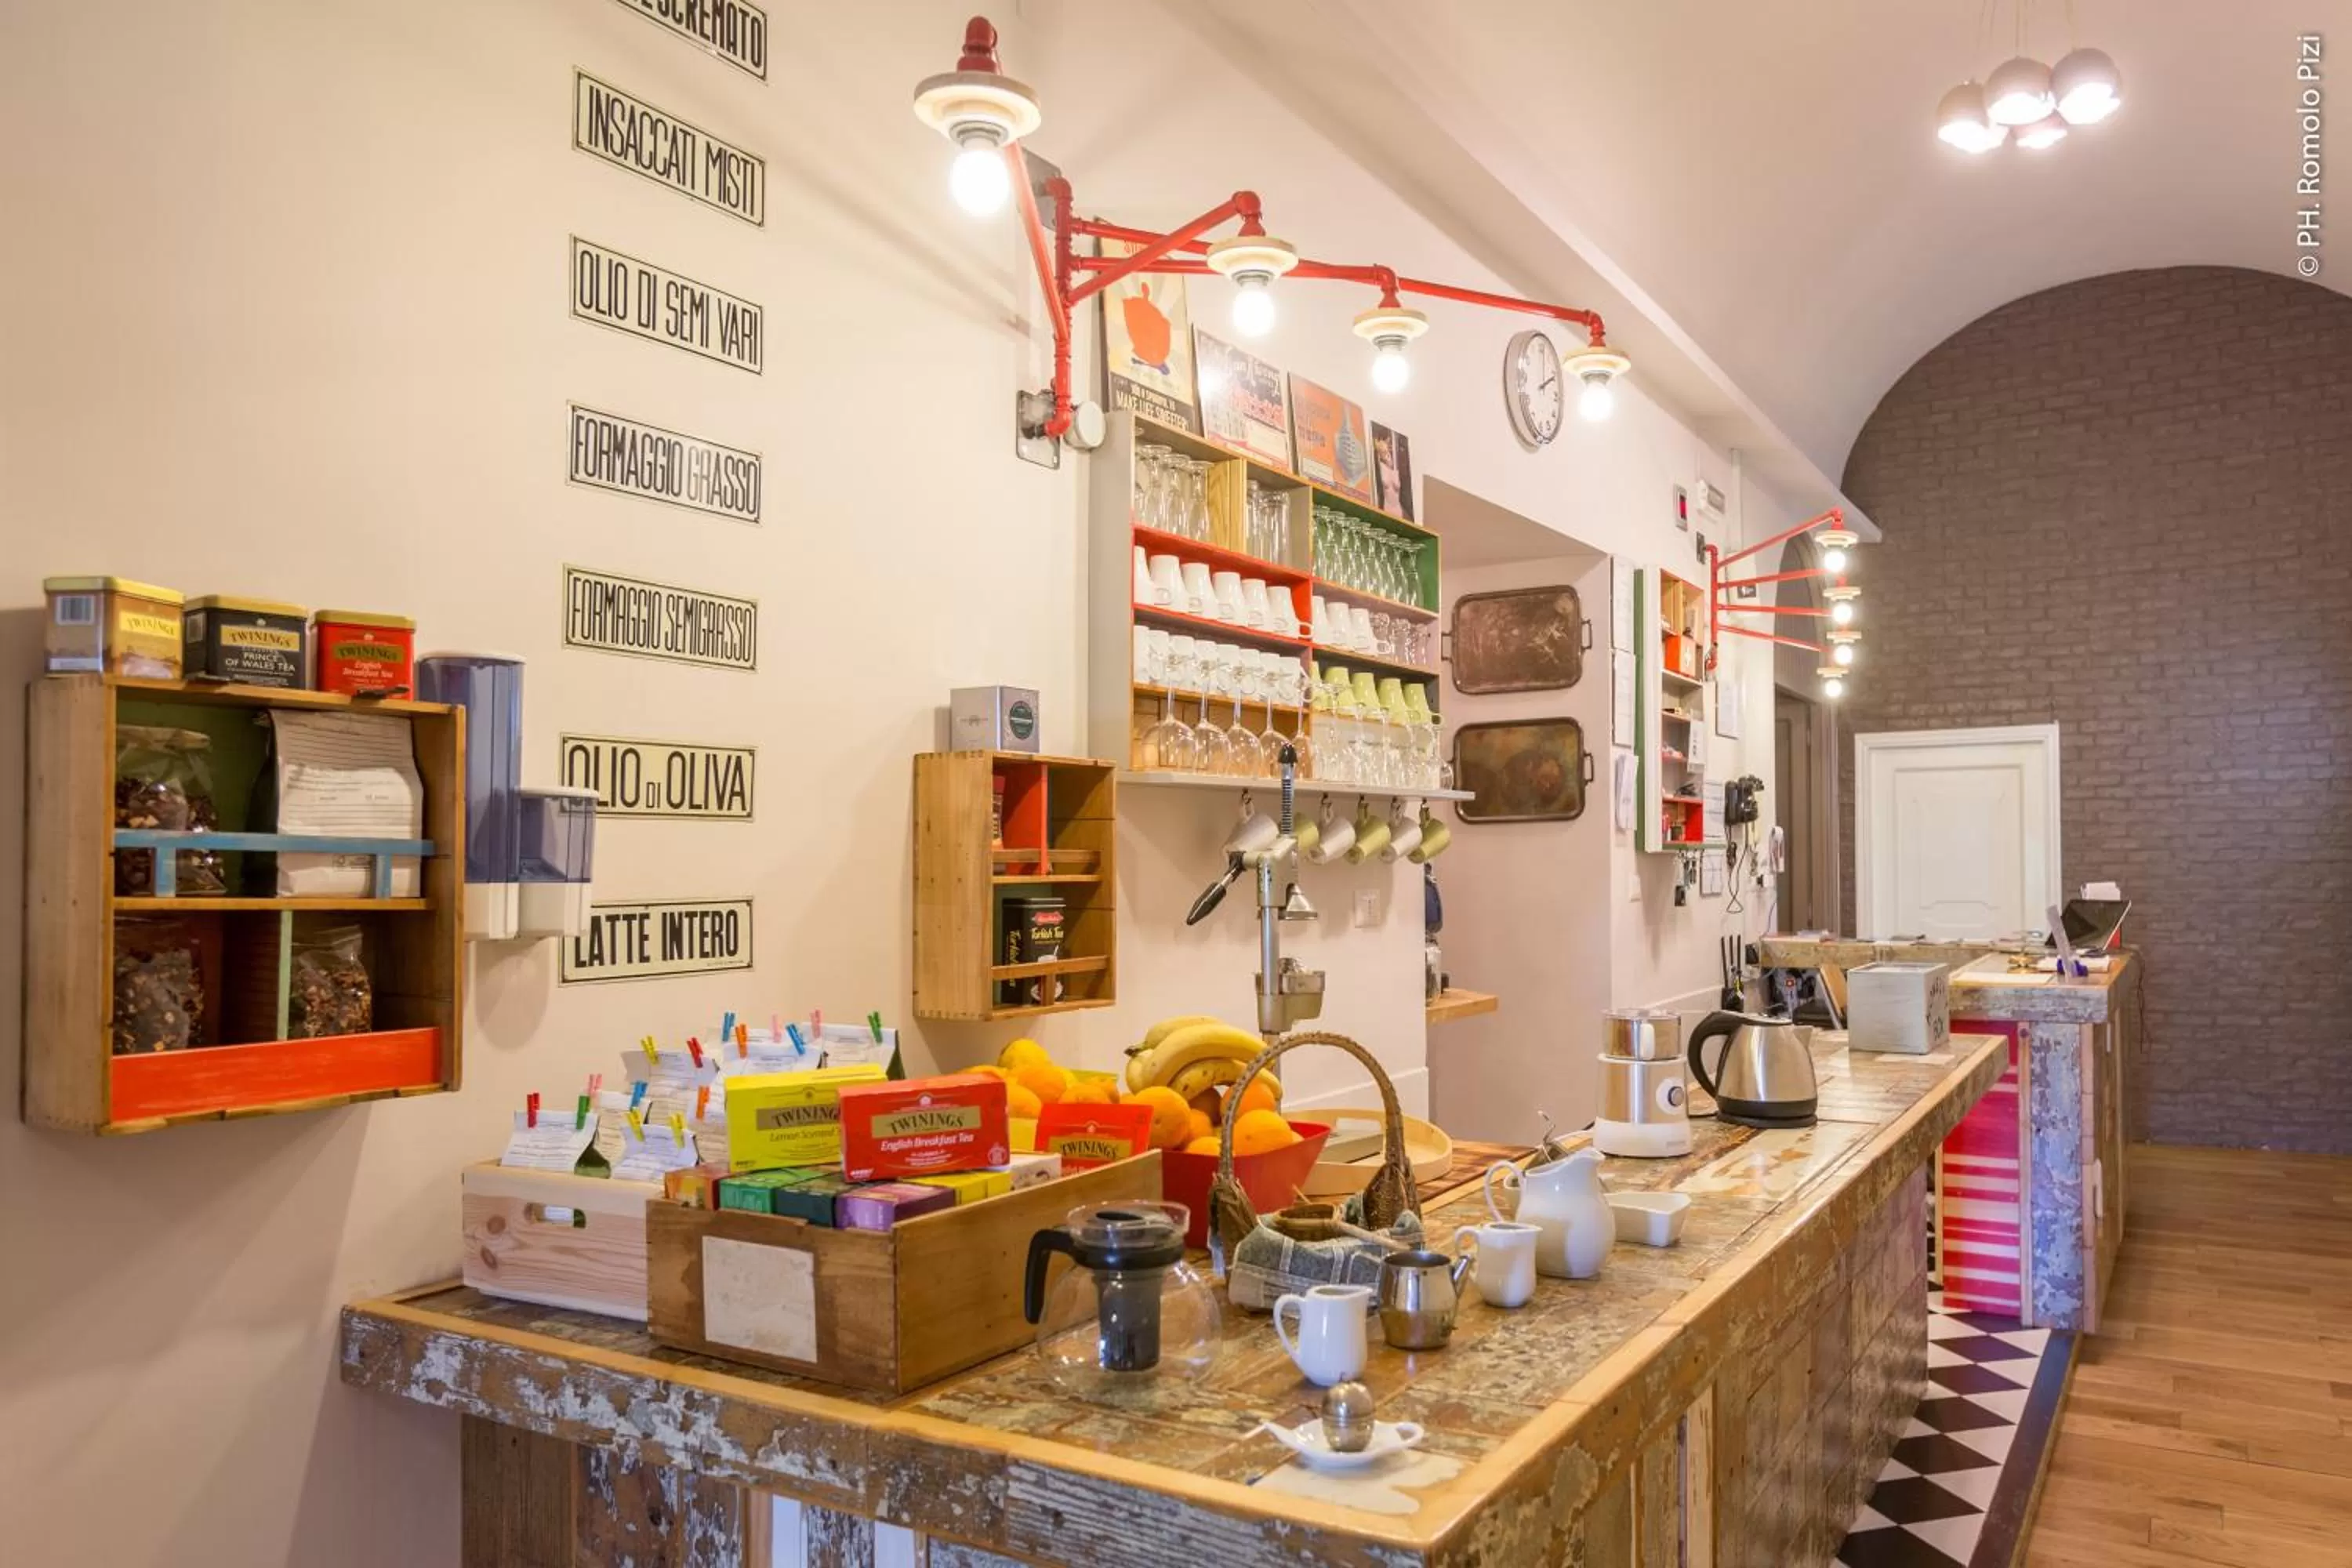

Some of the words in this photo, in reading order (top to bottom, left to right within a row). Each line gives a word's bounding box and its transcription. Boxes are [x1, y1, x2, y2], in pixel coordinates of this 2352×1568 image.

[588, 84, 695, 190] INSACCATI
[705, 140, 755, 217] MISTI
[579, 249, 628, 320] OLIO
[637, 269, 657, 331] DI
[666, 280, 710, 348] SEMI
[717, 297, 758, 365] VARI
[575, 414, 684, 497] FORMAGGIO
[687, 445, 759, 514] GRASSO
[572, 576, 661, 650] FORMAGGIO
[665, 593, 752, 662] SEMIGRASSO
[228, 630, 291, 648] TWININGS
[225, 658, 240, 666] OF
[241, 659, 276, 671] WALES
[277, 662, 296, 673] TEA
[243, 651, 278, 662] PRINCE
[568, 745, 641, 808] OLIO
[645, 782, 661, 809] DI
[666, 750, 747, 811] OLIVA
[575, 912, 651, 968] LATTE
[660, 909, 739, 962] INTERO
[771, 1106, 841, 1127] TWINING
[889, 1112, 965, 1134] TWININGS
[880, 1138, 913, 1152] English
[913, 1134, 957, 1147] Breakfast
[958, 1131, 975, 1143] Tea
[1060, 1141, 1119, 1159] TWININGS
